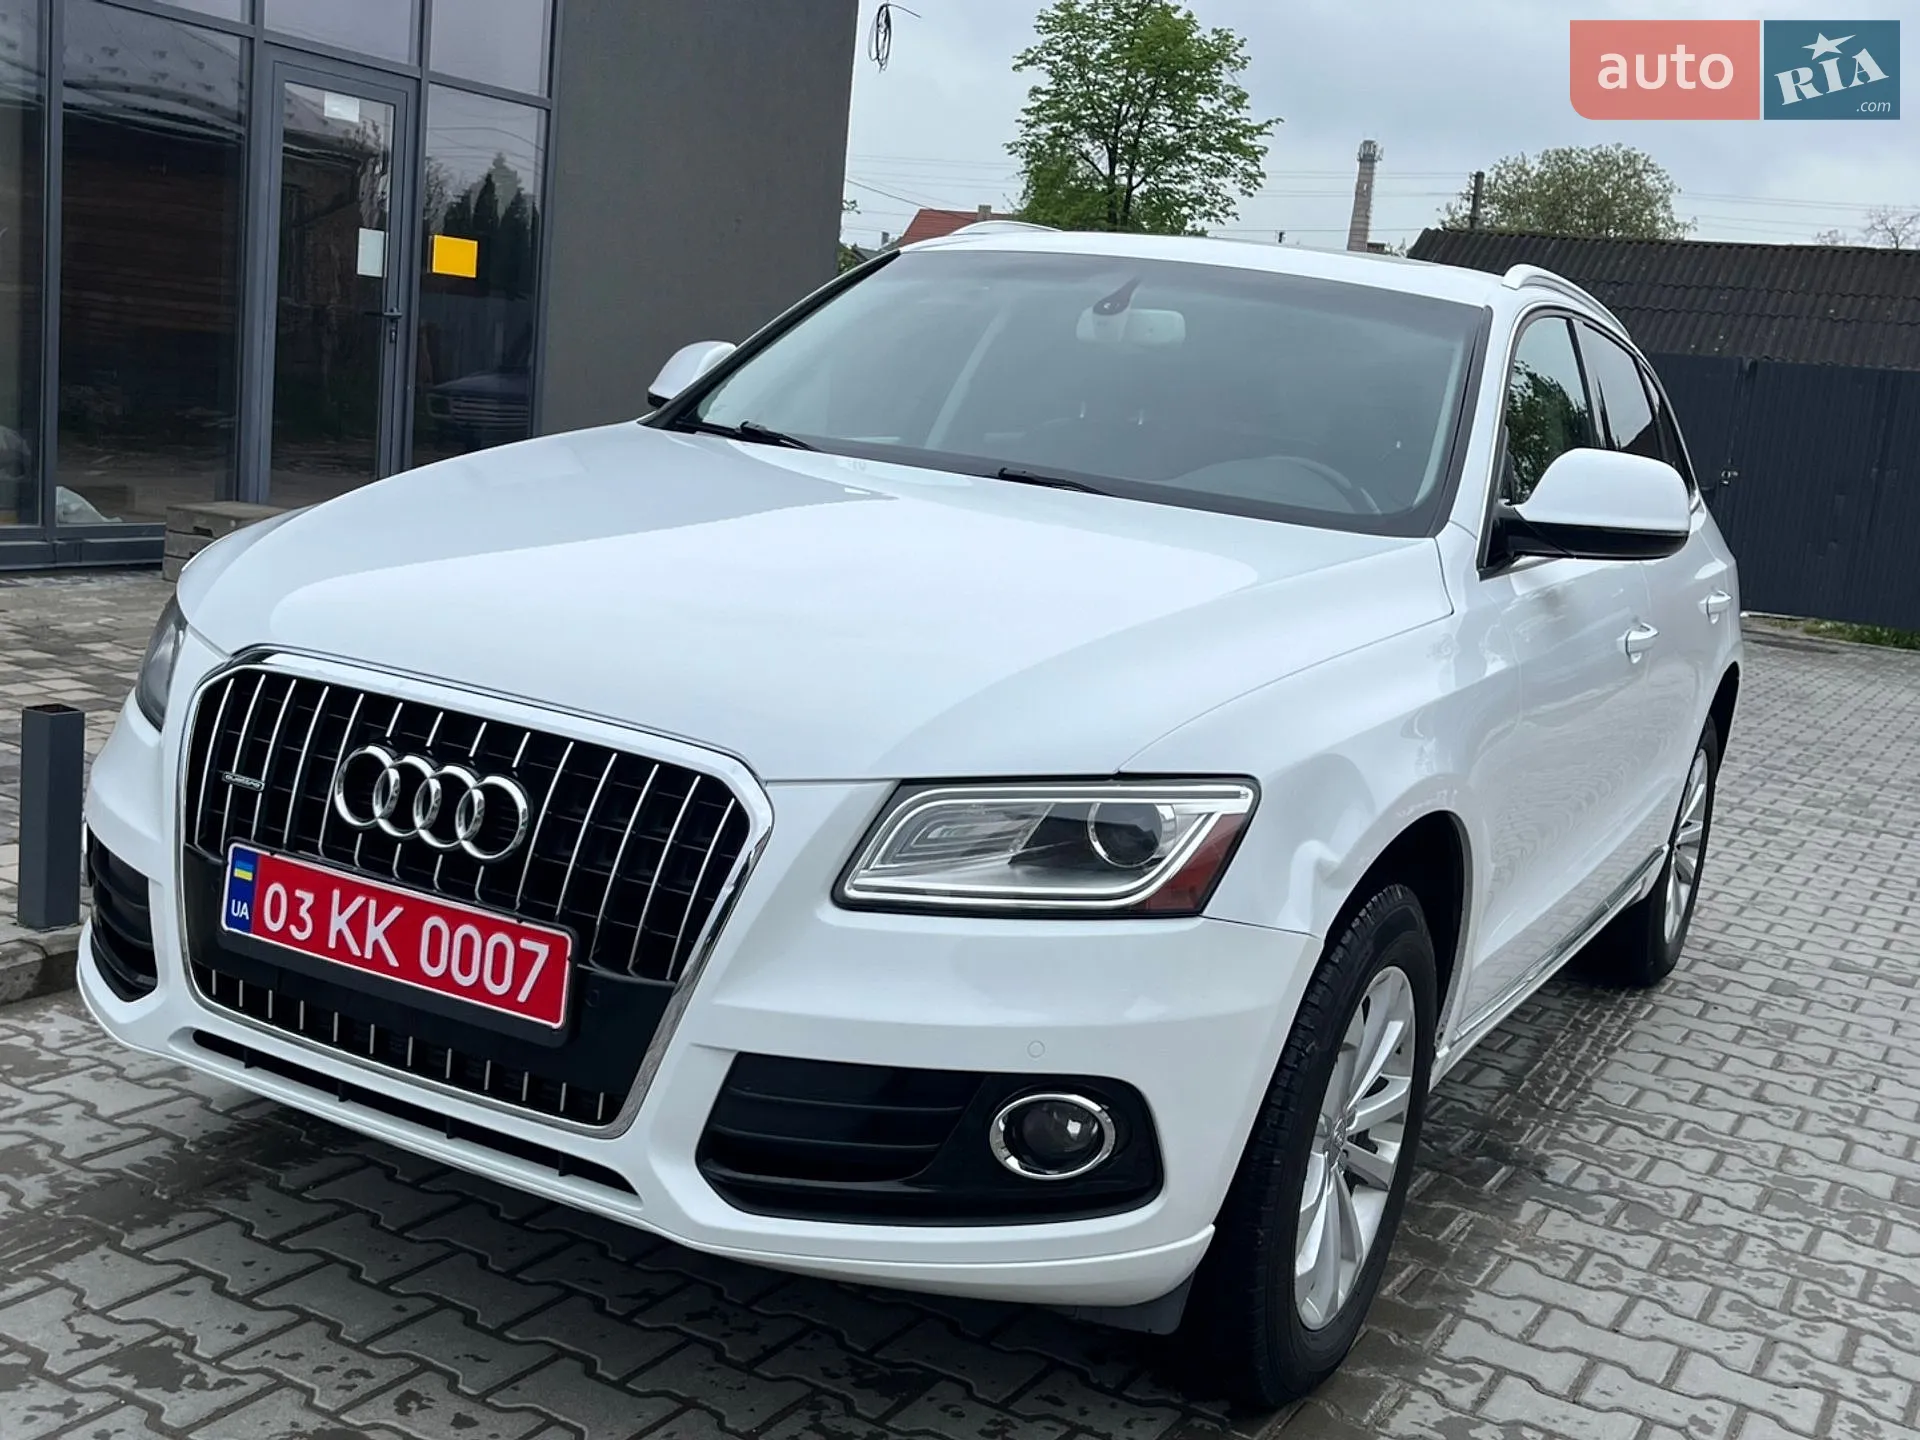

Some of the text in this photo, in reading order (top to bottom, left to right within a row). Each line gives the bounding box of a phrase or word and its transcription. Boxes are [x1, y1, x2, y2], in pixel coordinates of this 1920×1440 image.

[231, 898, 250, 921] UA
[263, 882, 550, 1003] 03 KK 0007
